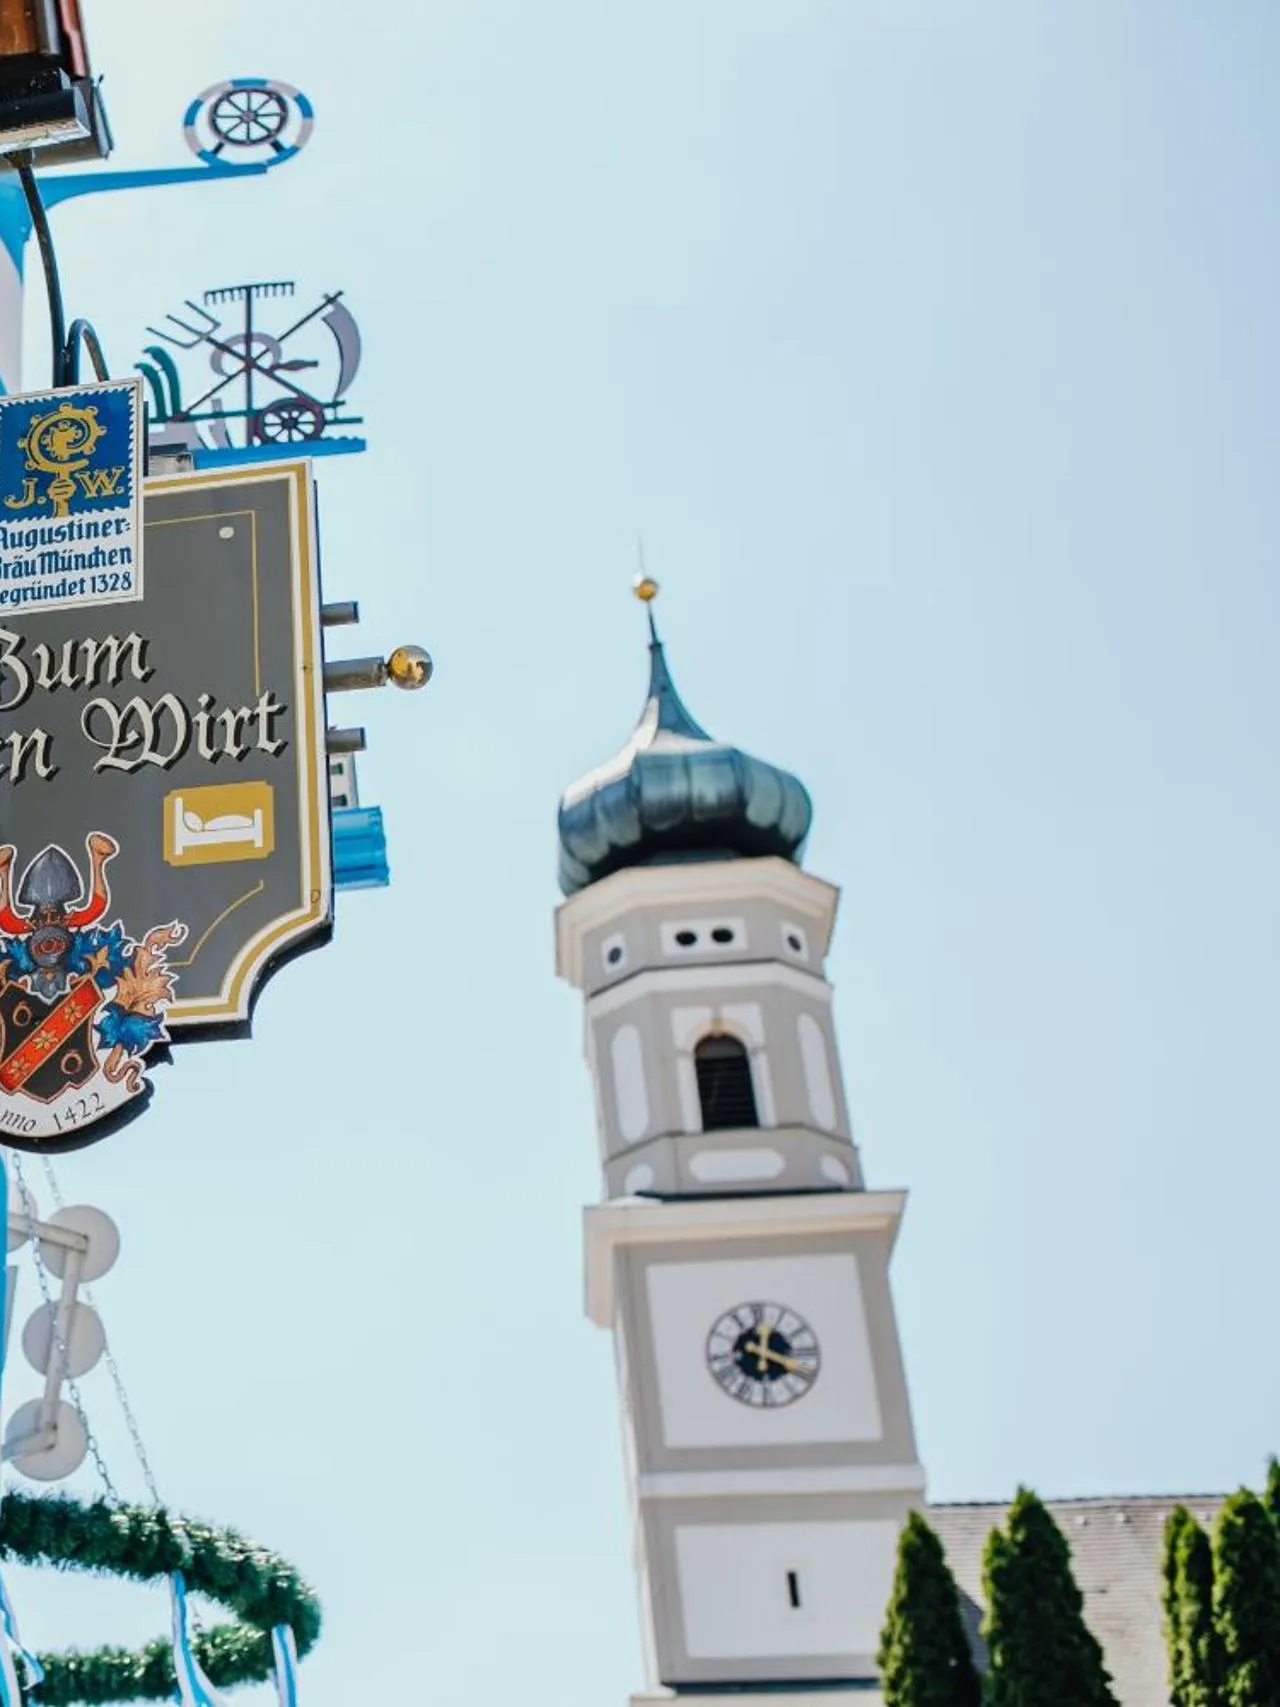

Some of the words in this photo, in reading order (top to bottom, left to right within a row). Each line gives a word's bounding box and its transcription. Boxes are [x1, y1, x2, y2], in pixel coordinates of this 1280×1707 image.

[37, 546, 133, 576] München
[90, 571, 133, 594] 1328
[80, 690, 287, 775] Wirt
[51, 1091, 106, 1131] 1422
